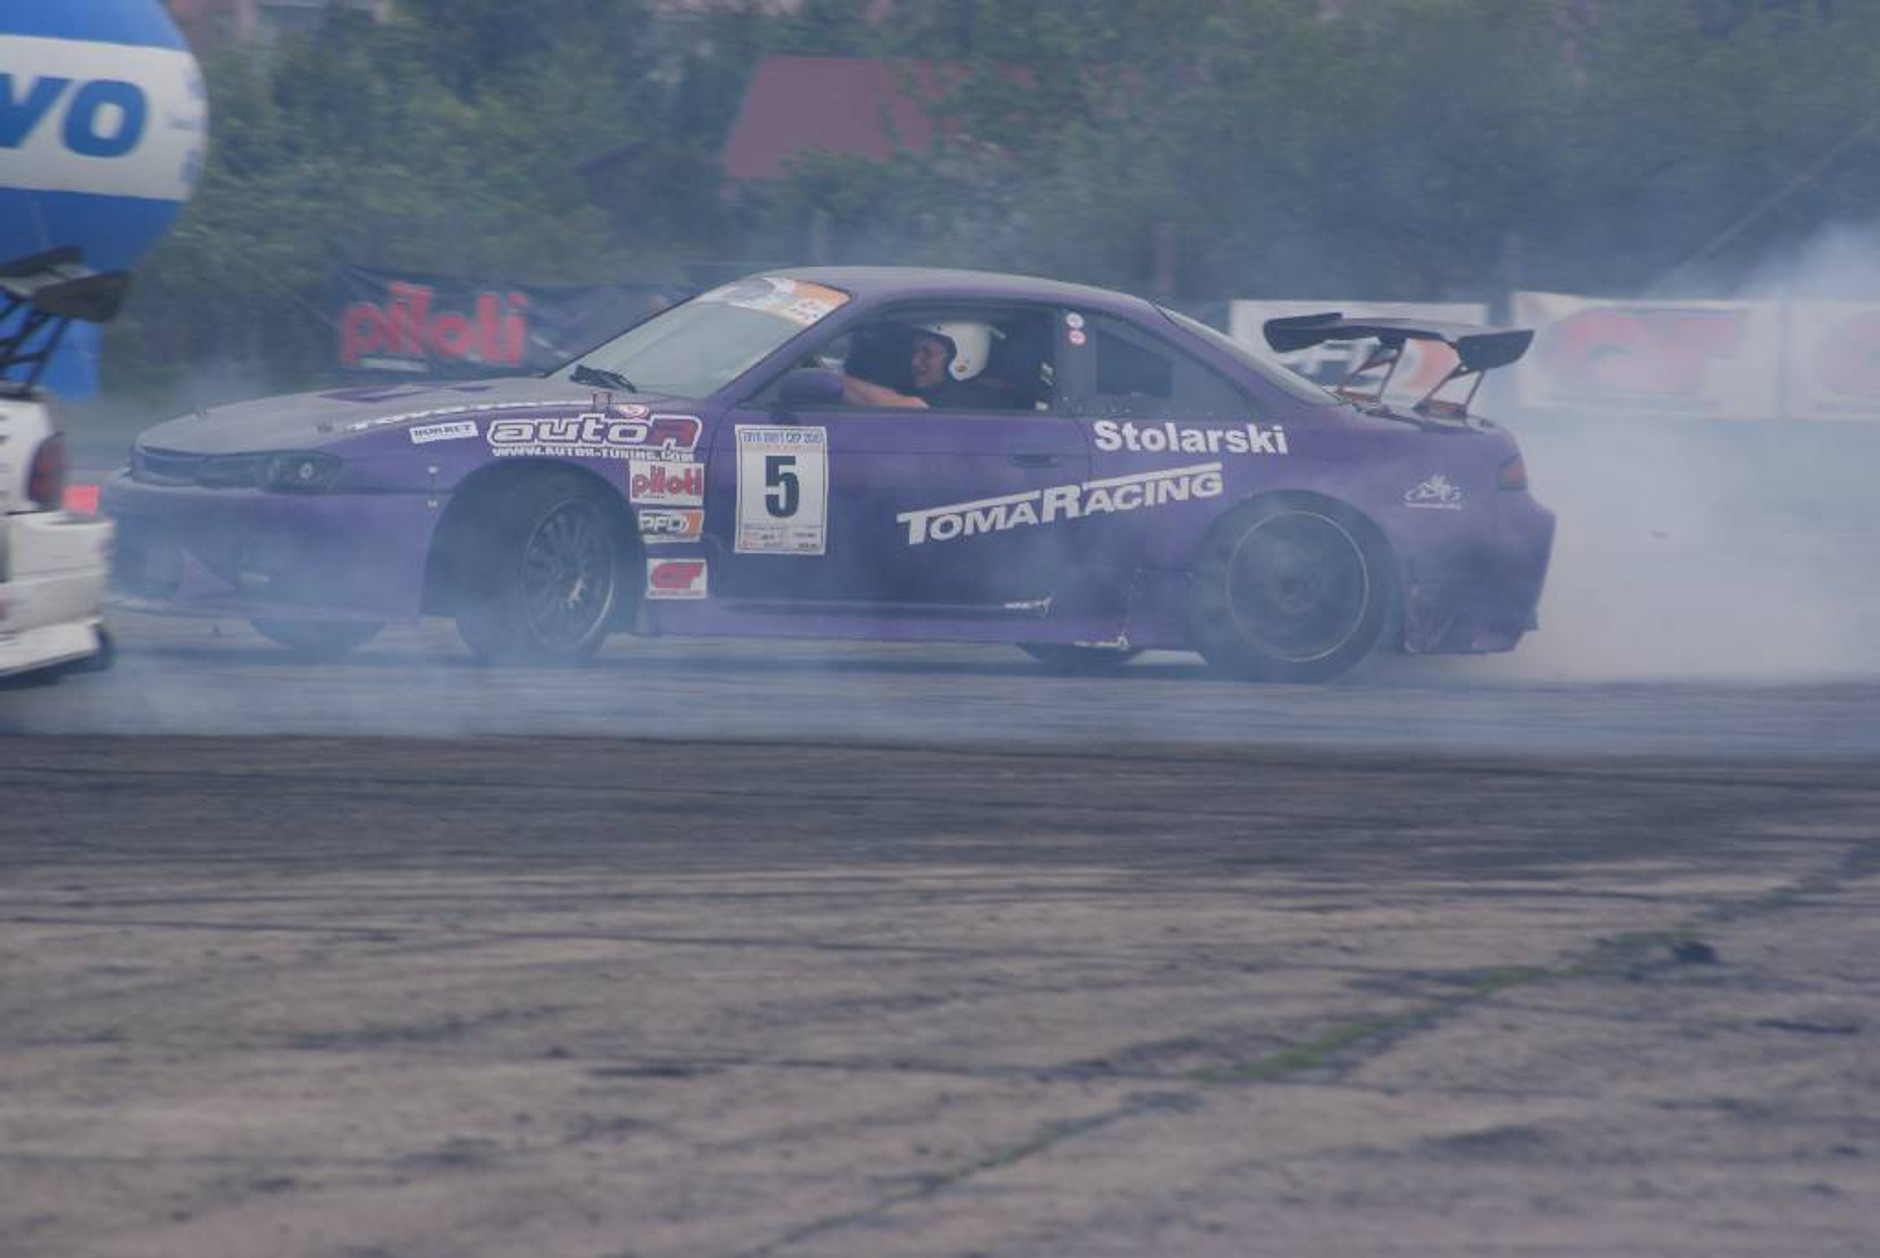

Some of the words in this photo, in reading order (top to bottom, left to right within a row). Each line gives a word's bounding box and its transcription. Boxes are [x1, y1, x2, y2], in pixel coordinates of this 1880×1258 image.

[340, 280, 528, 368] piloti
[1093, 420, 1289, 455] Stolarski
[765, 455, 800, 518] 5
